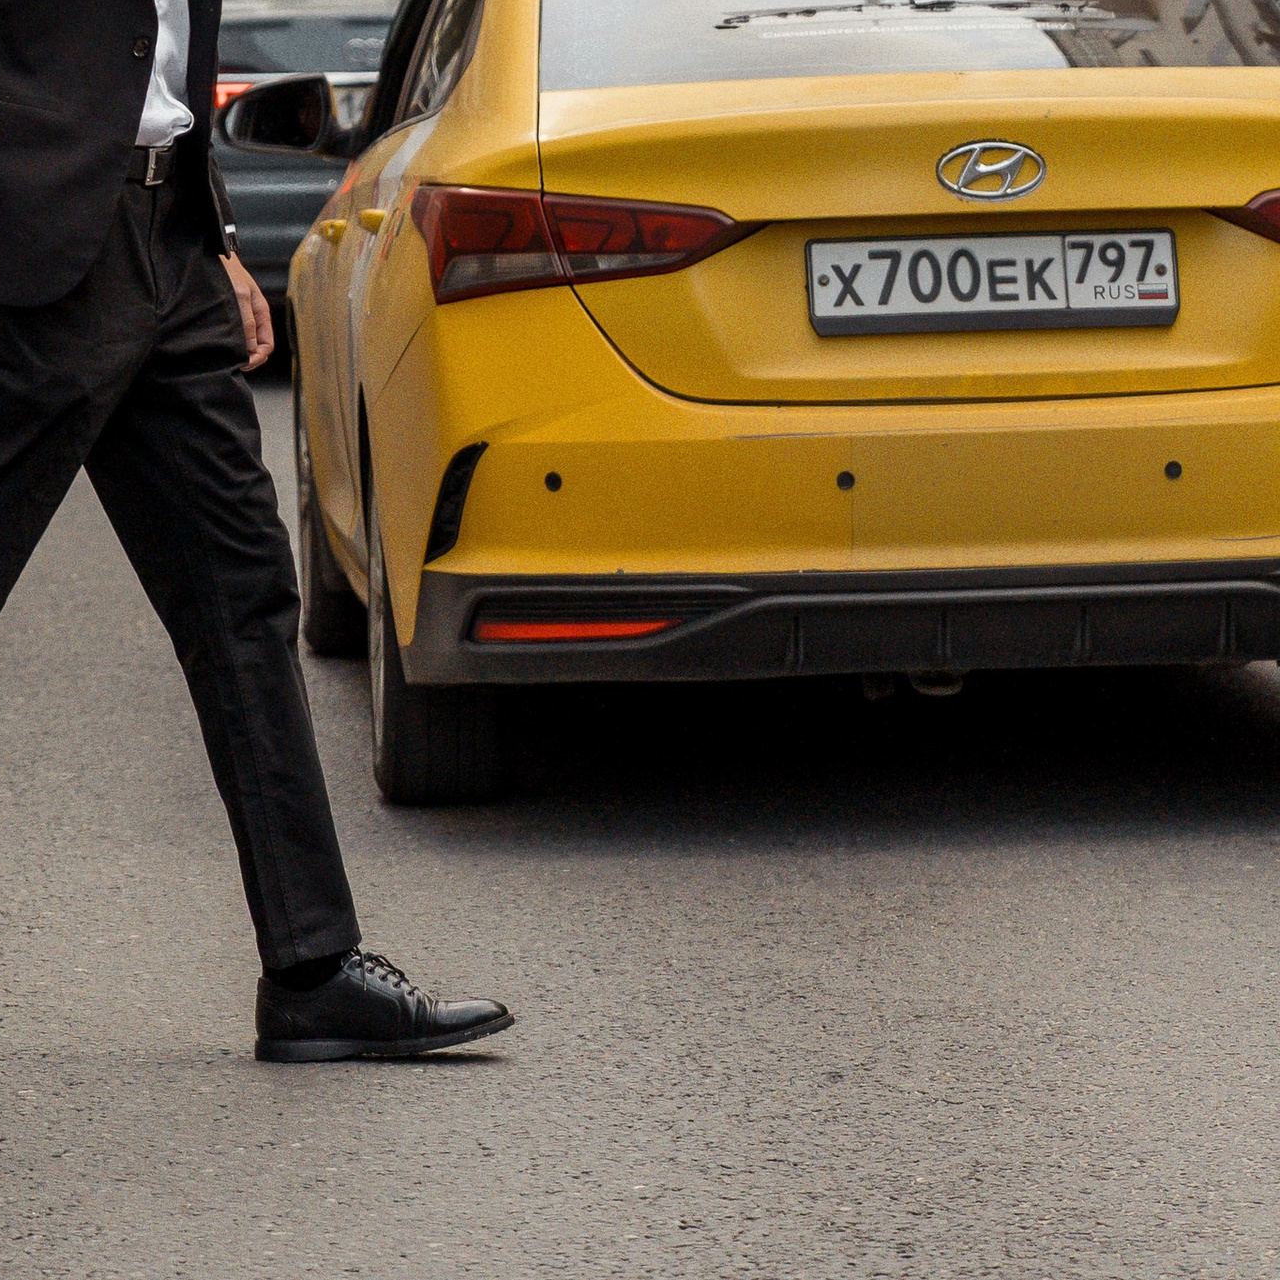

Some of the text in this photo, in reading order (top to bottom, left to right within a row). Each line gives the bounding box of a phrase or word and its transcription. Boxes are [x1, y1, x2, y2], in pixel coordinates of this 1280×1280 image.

[830, 239, 1155, 307] Х700ЕК 797
[1093, 283, 1136, 300] RUS
